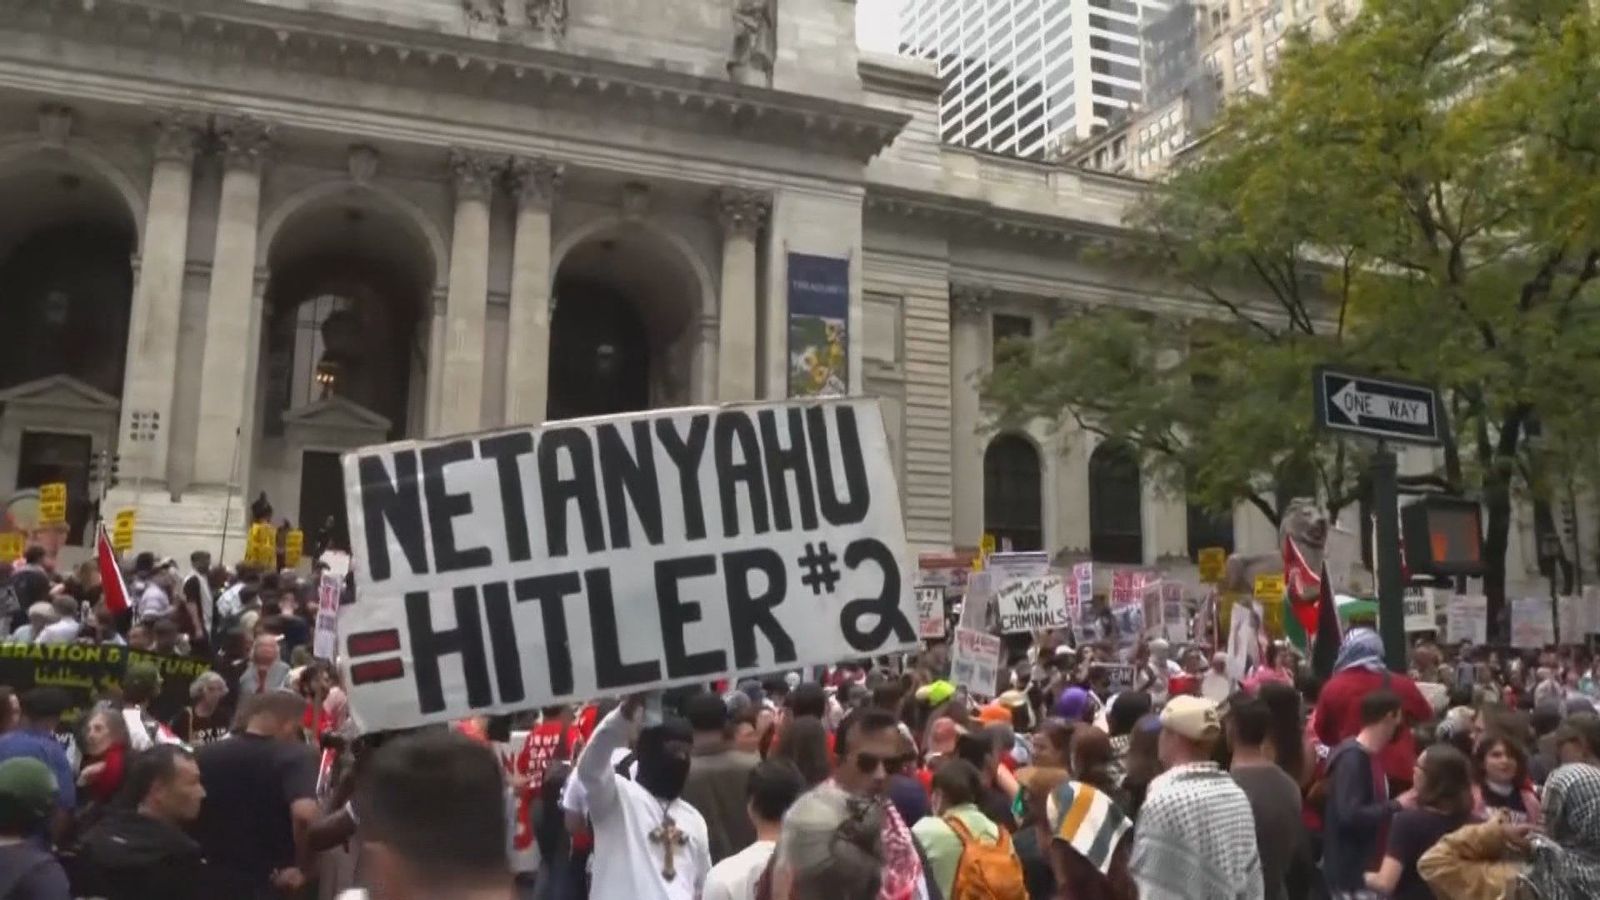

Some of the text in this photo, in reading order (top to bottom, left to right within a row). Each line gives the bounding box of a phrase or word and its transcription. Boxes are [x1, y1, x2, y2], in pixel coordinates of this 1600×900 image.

[1344, 392, 1419, 419] ONE WAY
[358, 405, 871, 582] NETANYAHU
[1014, 593, 1049, 611] WAR
[1001, 608, 1067, 631] CRIMINALS
